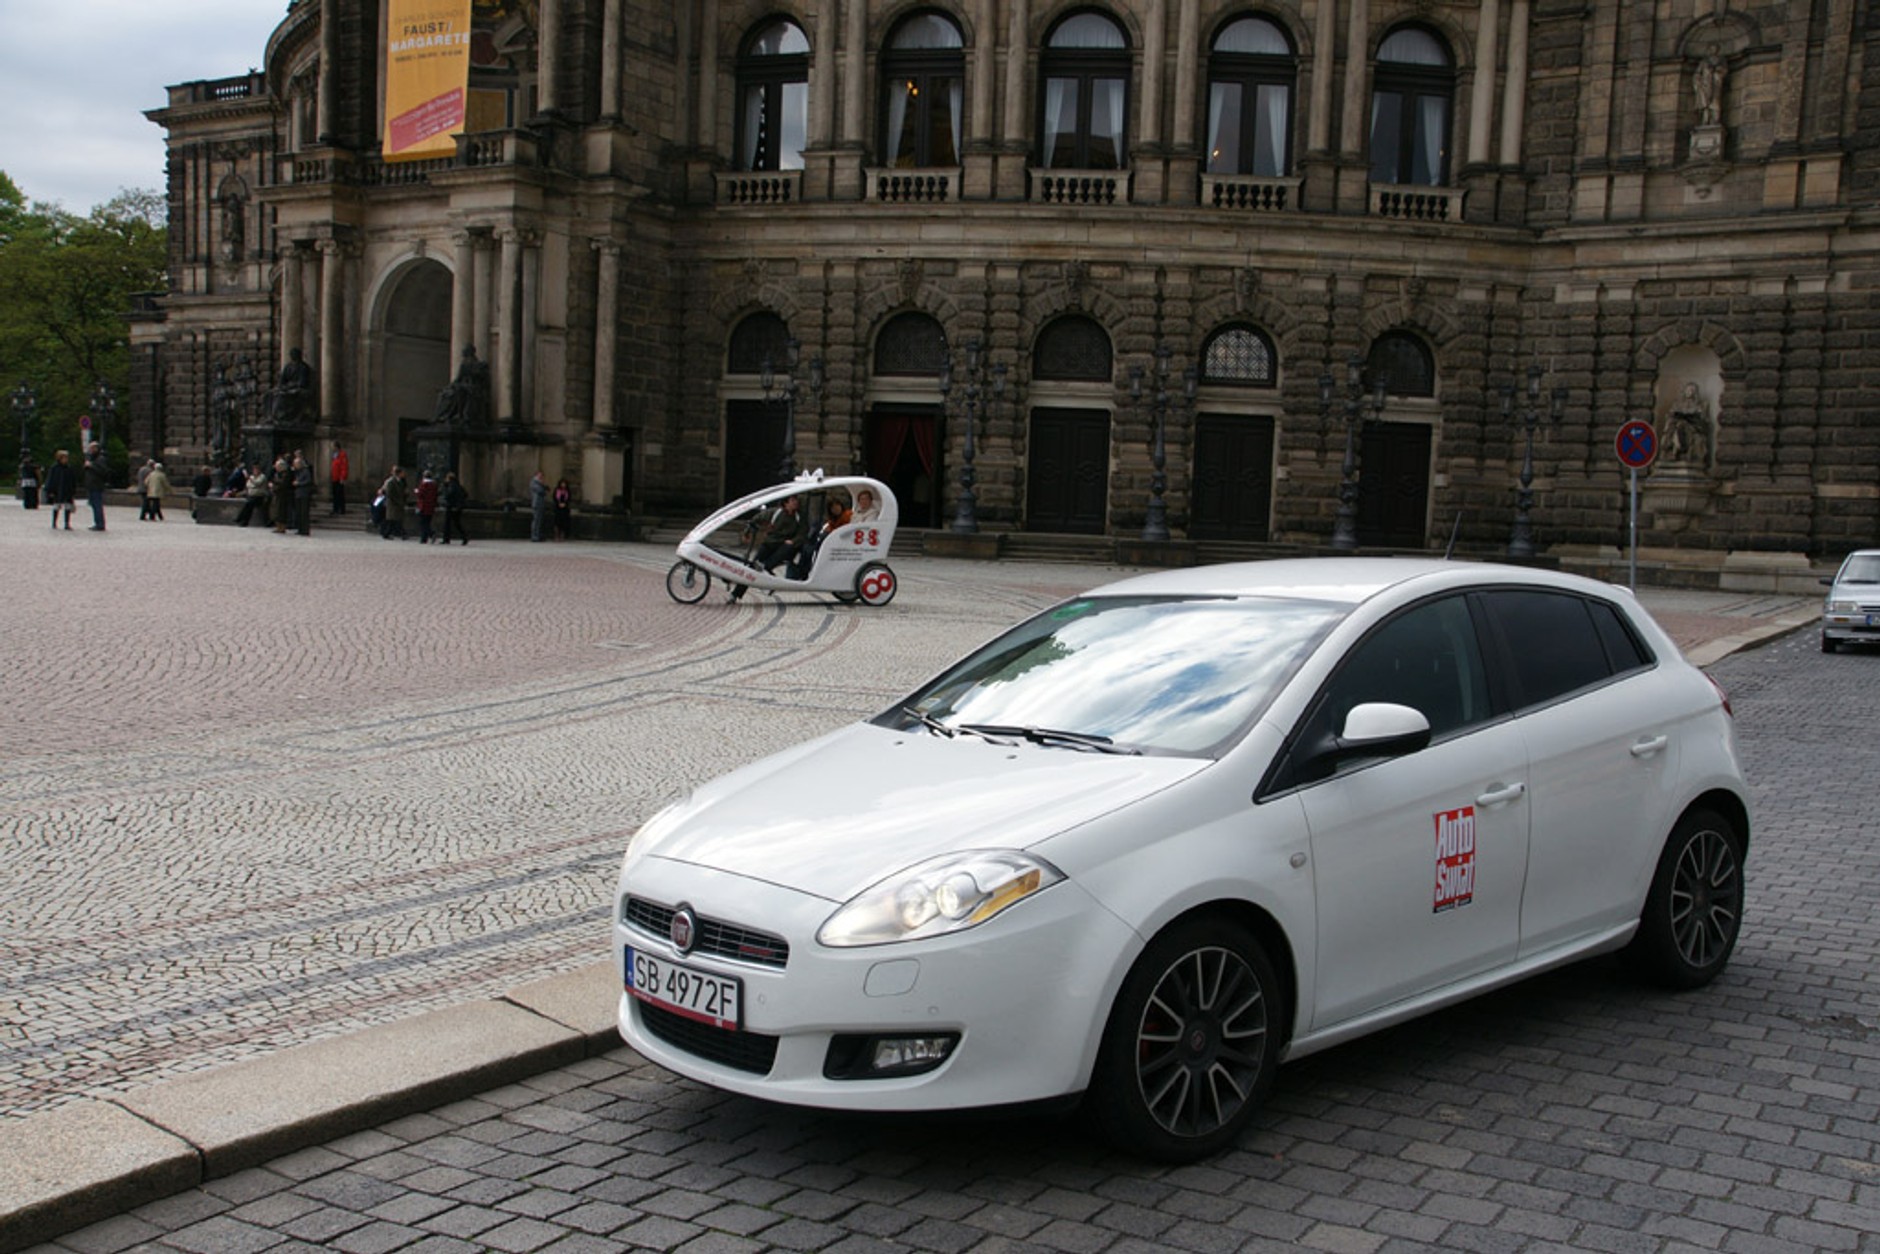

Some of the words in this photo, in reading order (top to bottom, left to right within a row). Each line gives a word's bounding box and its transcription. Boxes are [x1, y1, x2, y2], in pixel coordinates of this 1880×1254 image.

[1436, 809, 1474, 861] Auto
[635, 954, 660, 994] SB
[666, 968, 735, 1017] 4972F
